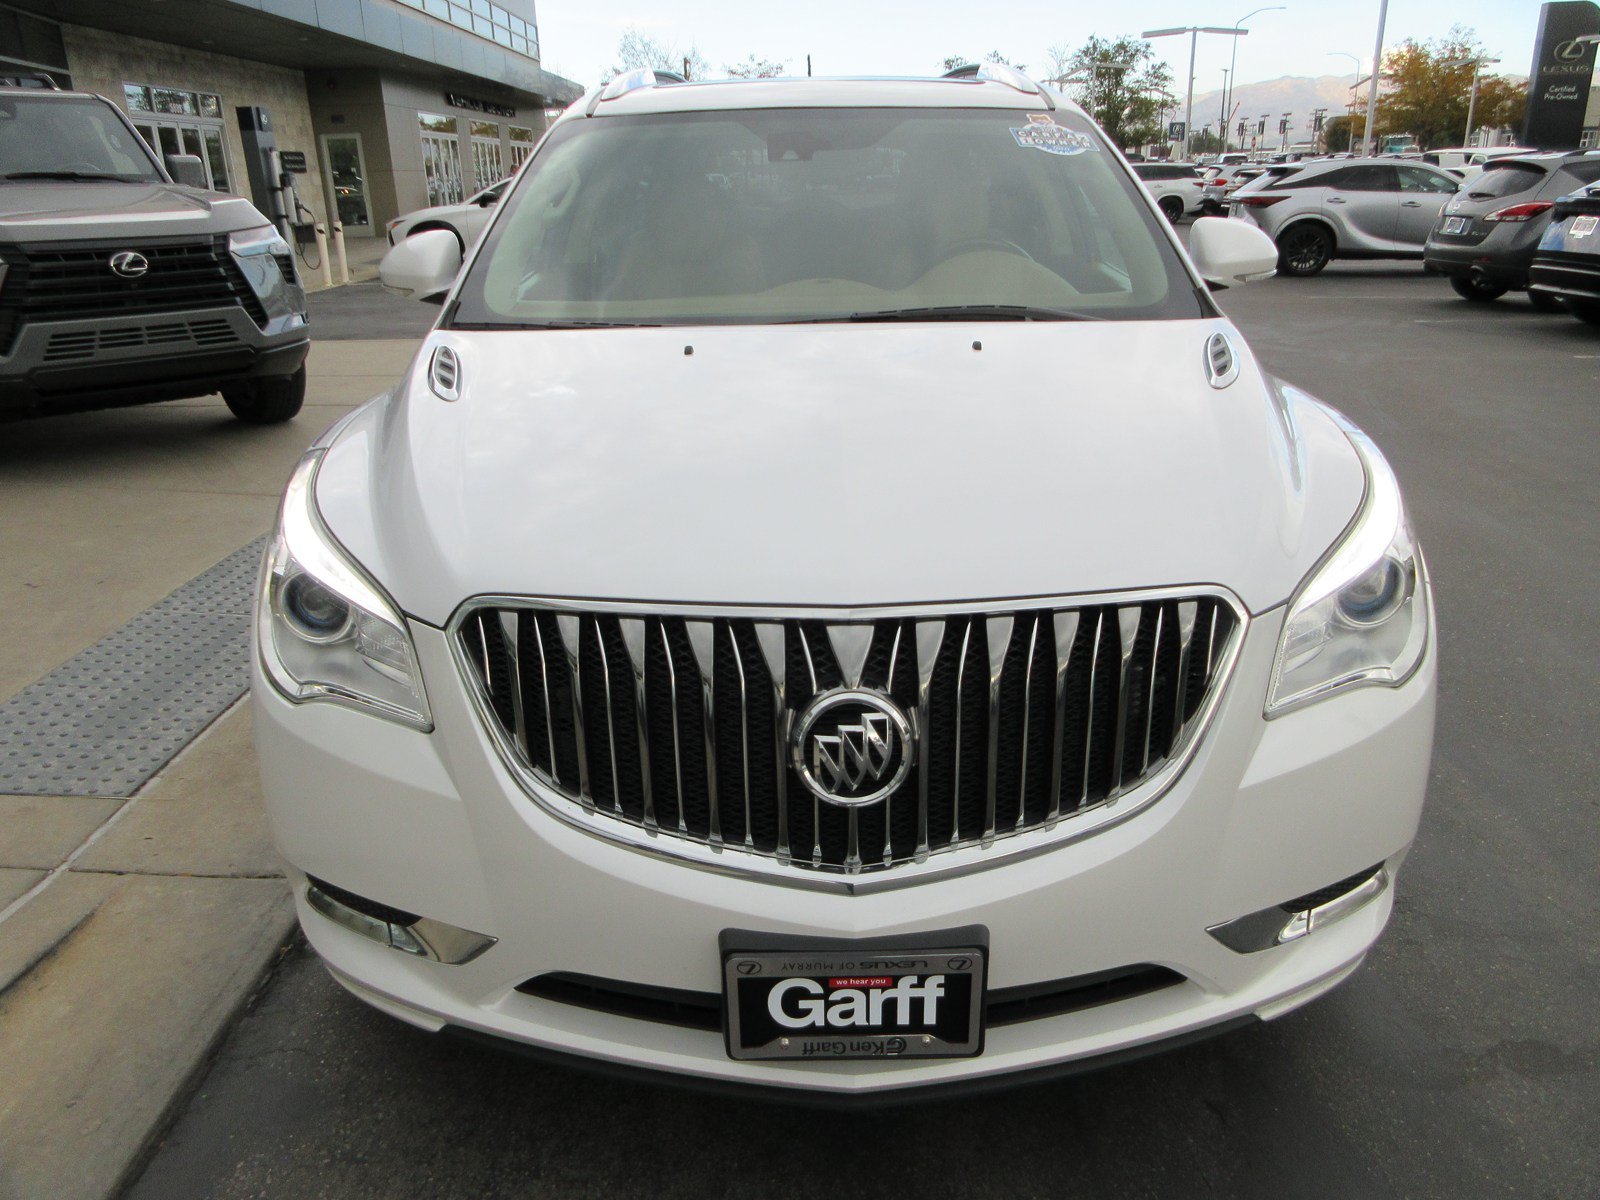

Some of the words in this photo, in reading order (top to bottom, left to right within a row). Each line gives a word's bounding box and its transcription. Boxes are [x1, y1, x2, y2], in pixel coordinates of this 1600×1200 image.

[781, 962, 833, 971] MURRAY
[839, 962, 855, 970] OF
[859, 960, 928, 970] LEXUS
[870, 978, 887, 986] you
[767, 974, 945, 1029] Garff
[801, 1042, 846, 1055] Garff
[850, 1041, 884, 1055] Ken
